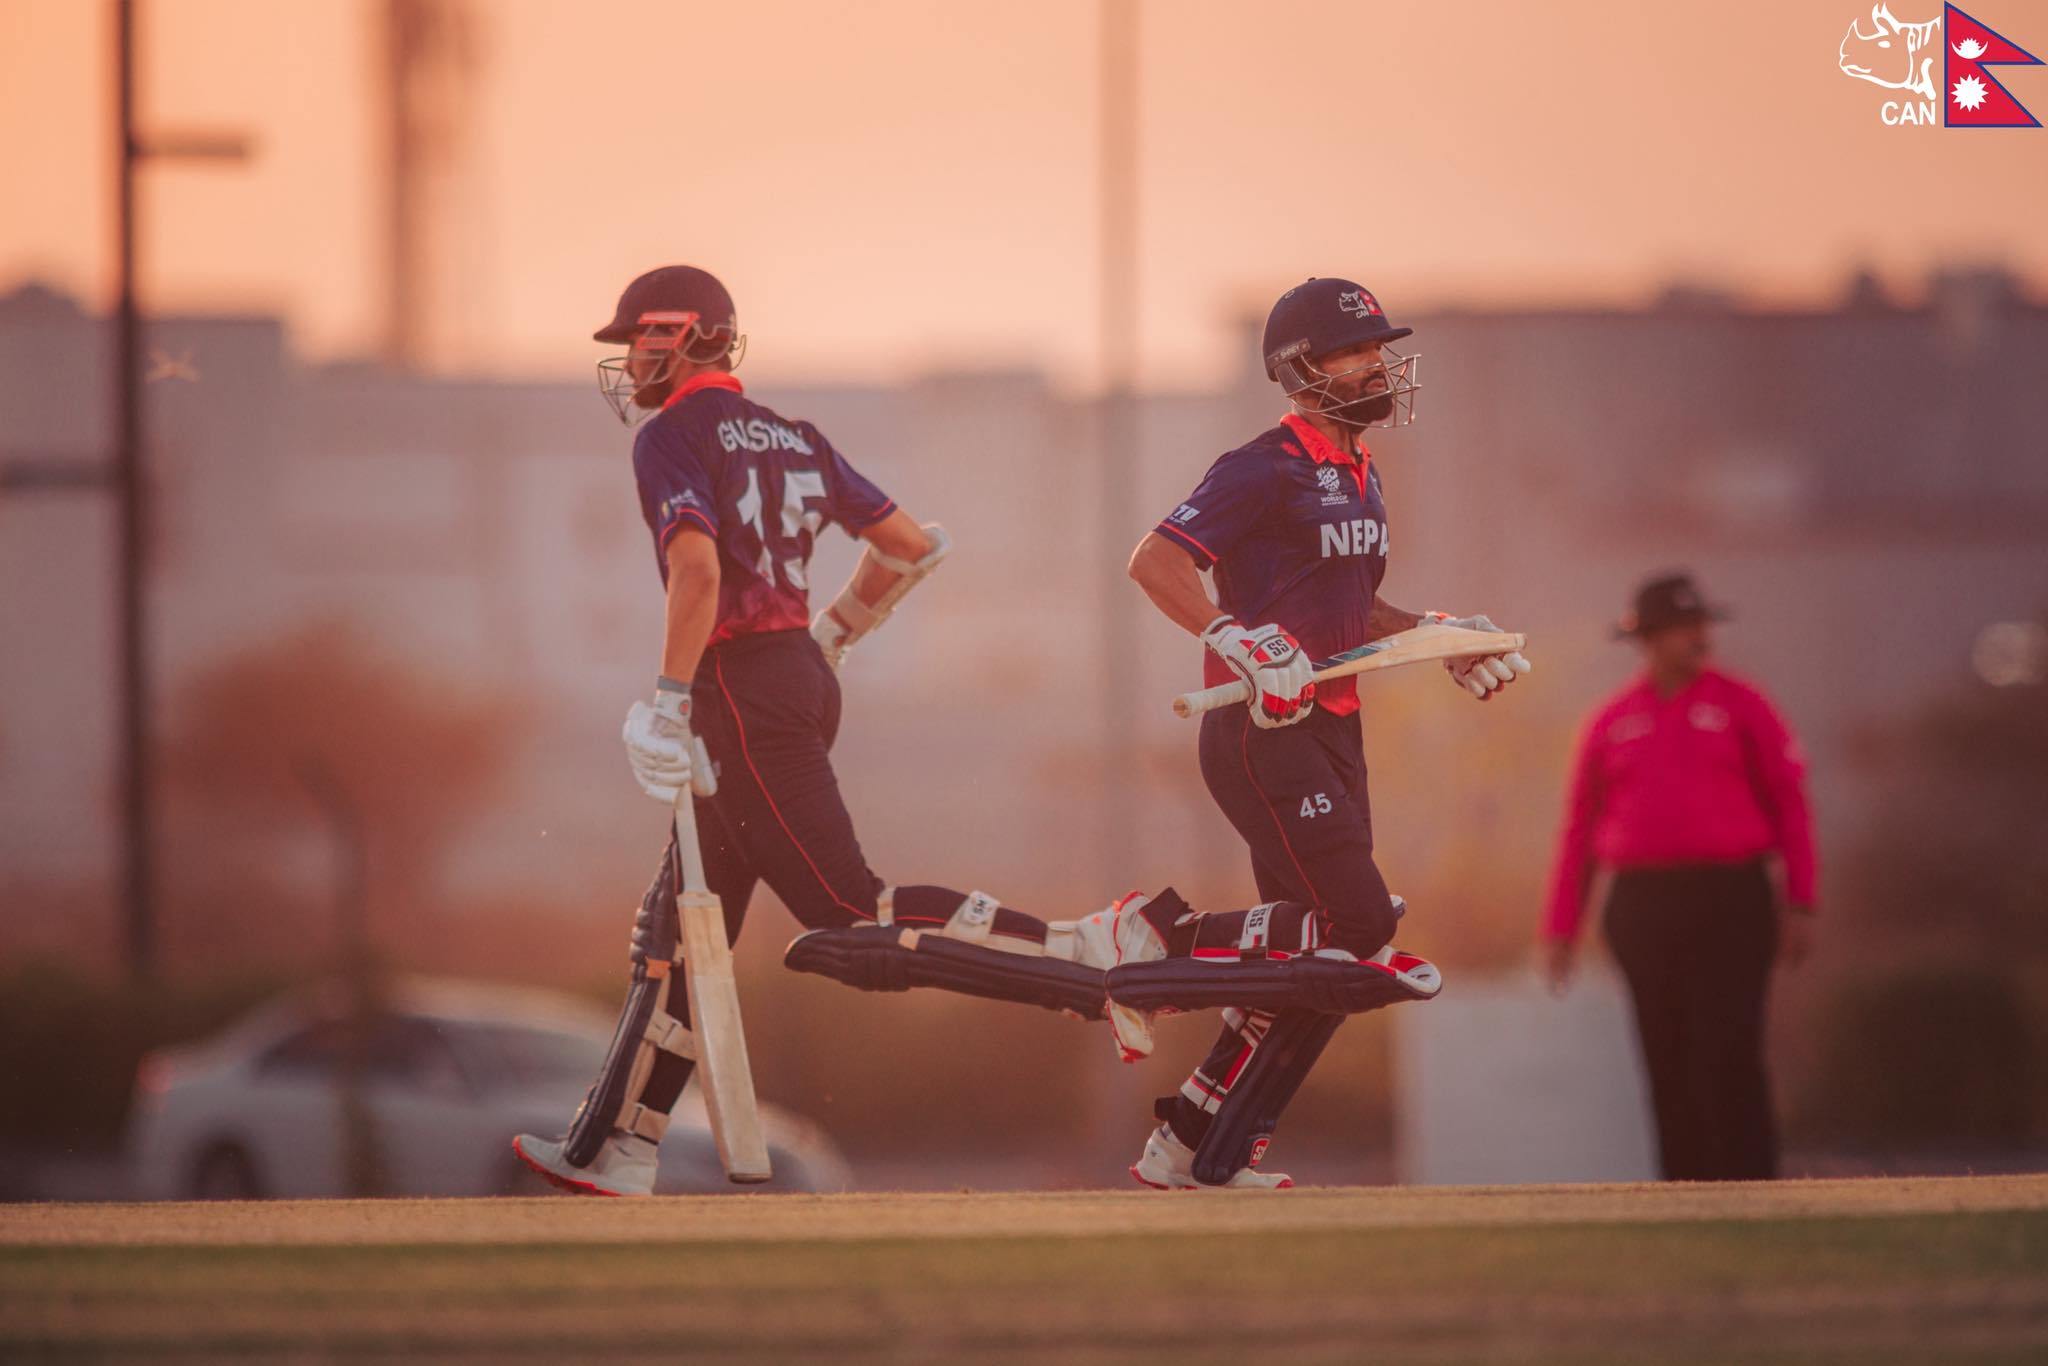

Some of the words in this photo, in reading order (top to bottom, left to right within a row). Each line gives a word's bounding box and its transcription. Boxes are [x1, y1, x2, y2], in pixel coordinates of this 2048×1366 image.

[736, 467, 827, 590] 15
[1320, 519, 1389, 558] NEPA
[1266, 638, 1290, 657] SS
[1300, 793, 1332, 818] 45
